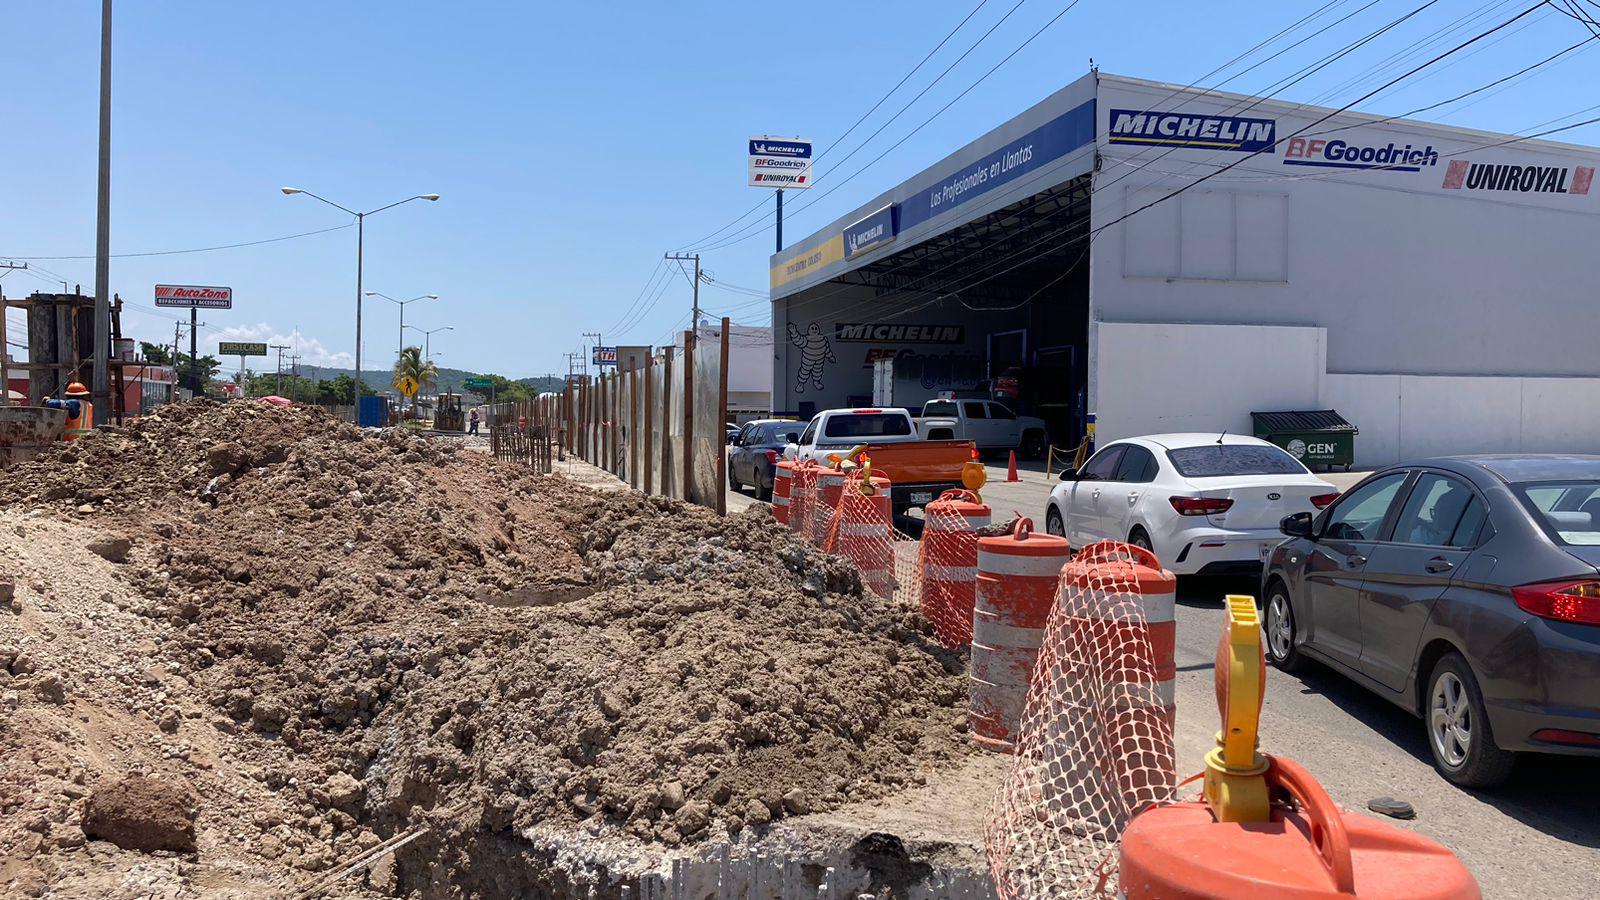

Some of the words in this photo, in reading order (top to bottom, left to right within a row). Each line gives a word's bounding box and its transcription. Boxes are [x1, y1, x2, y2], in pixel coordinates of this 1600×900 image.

[1112, 113, 1273, 142] MICHELIN
[1284, 136, 1439, 167] BFGoodrich
[755, 158, 806, 168] BFGoodrich
[763, 174, 797, 182] UNIROYAL
[930, 191, 942, 208] Los
[942, 167, 988, 202] Profesionales
[989, 161, 1000, 178] en
[1001, 145, 1033, 173] Llantas
[1466, 163, 1569, 194] UNIROYAL
[857, 223, 884, 245] MICHELIN
[173, 288, 228, 299] AutoZone
[840, 324, 960, 341] MICHELIN
[1307, 443, 1334, 454] GEN
